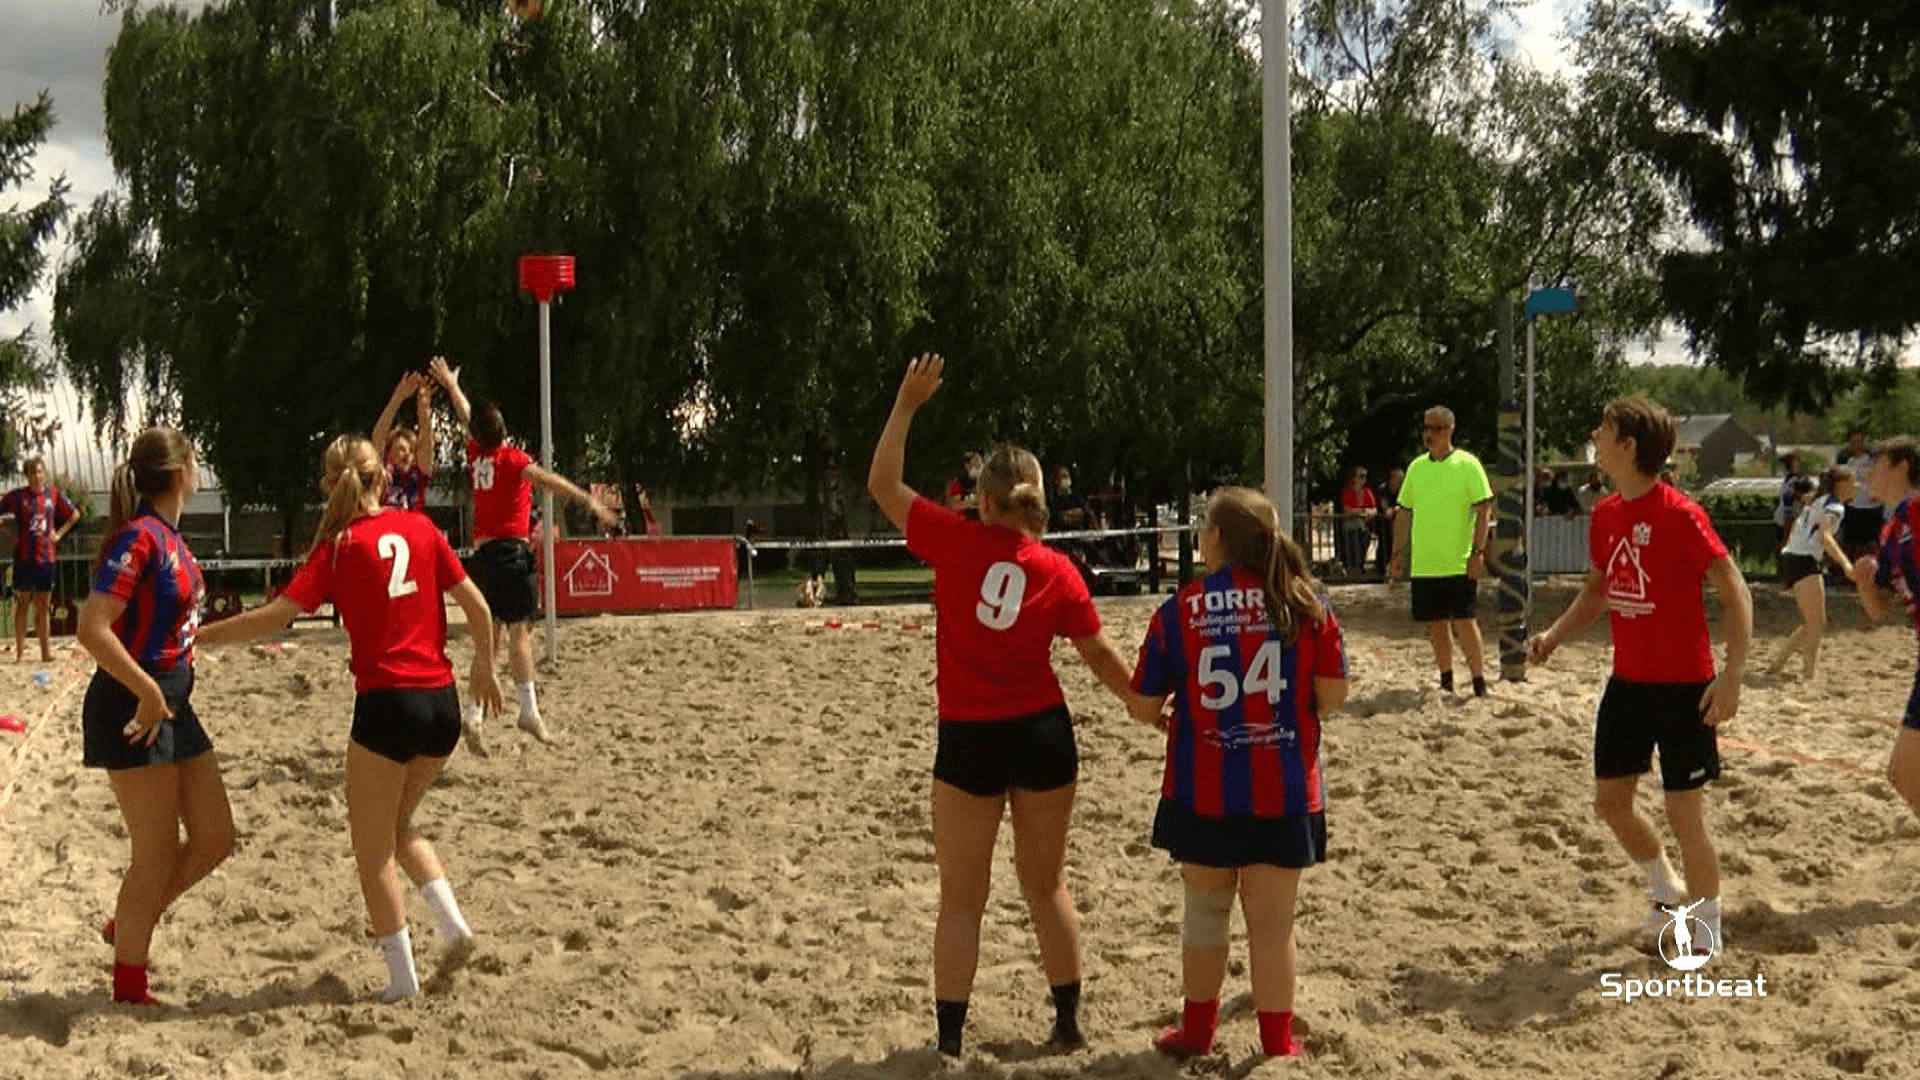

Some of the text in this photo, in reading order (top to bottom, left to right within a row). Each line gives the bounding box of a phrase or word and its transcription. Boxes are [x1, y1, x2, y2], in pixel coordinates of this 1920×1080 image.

[377, 533, 419, 598] 2
[976, 561, 1027, 630] 9
[1198, 639, 1287, 710] 54
